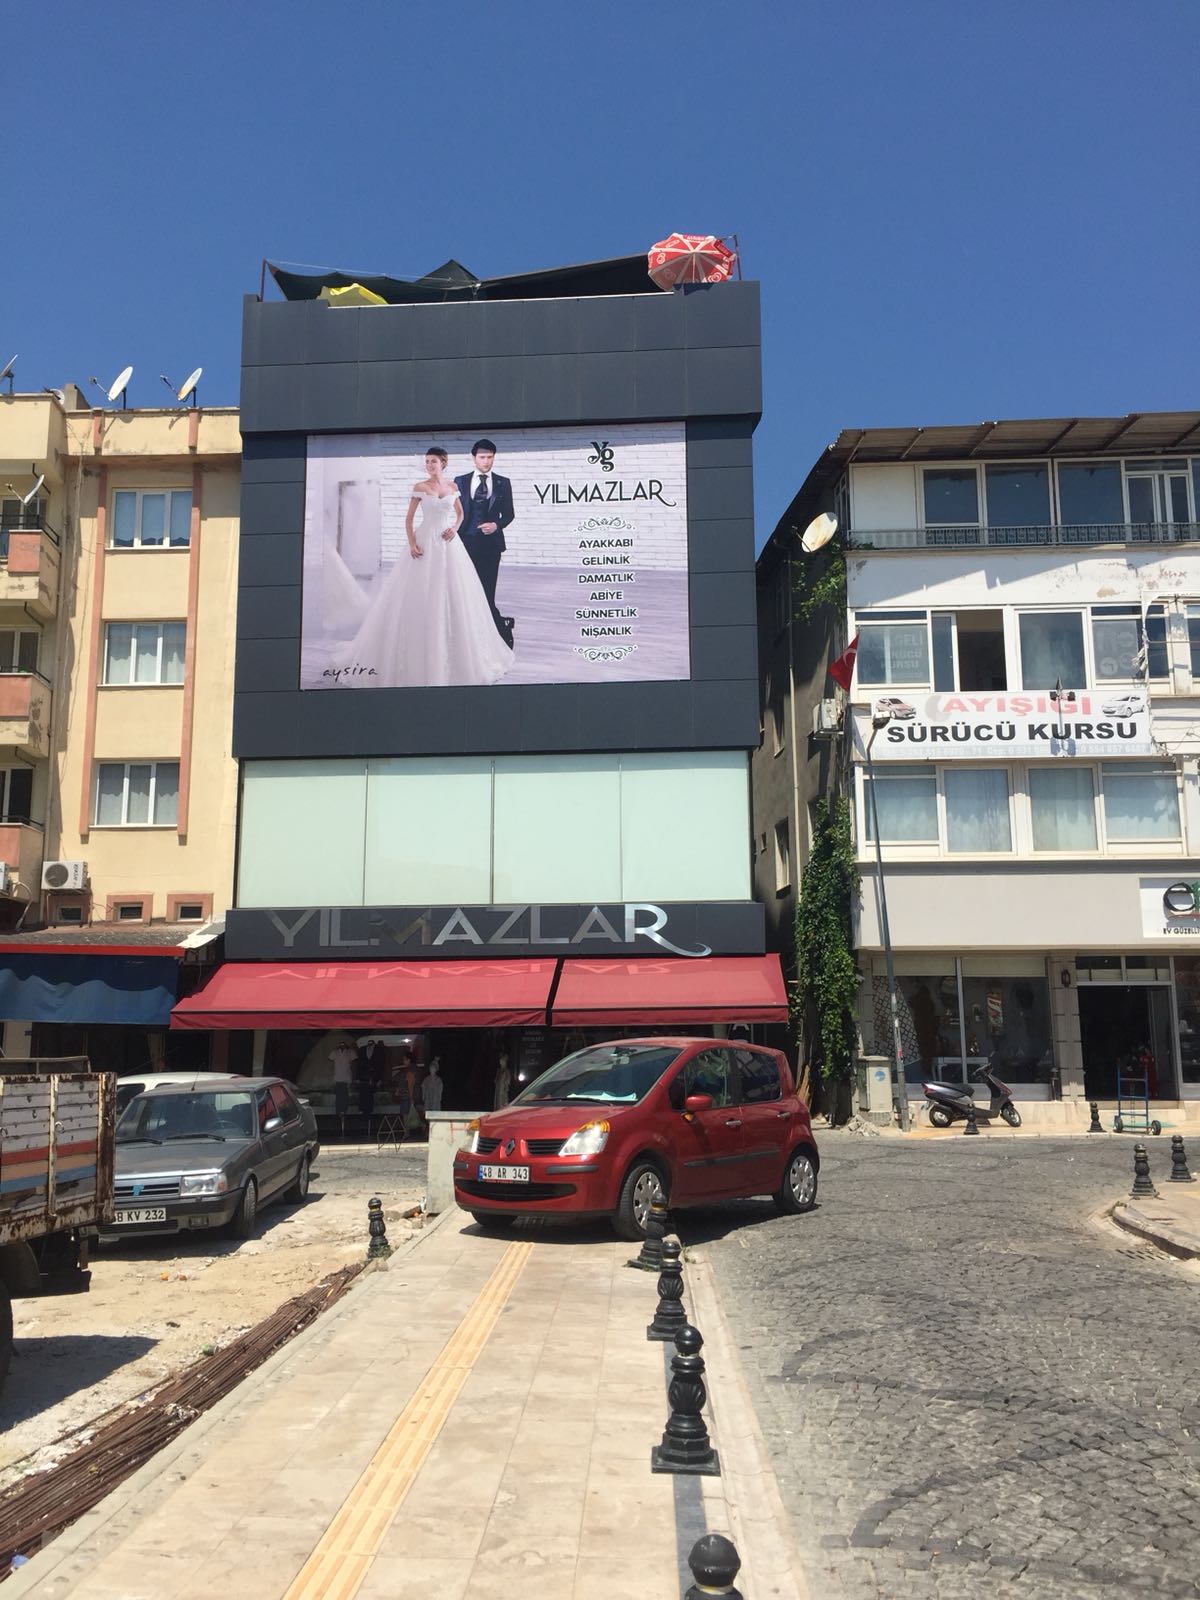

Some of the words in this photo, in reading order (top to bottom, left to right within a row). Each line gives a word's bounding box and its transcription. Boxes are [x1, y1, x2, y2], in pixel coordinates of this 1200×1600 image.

[534, 479, 677, 507] YILMAZLAR
[579, 538, 633, 549] AYAKKABI
[582, 554, 631, 566] GELİNLİK
[578, 573, 634, 583] DAMATLIK
[590, 589, 623, 601] ABİYE
[575, 606, 637, 619] SÜNNETLİK
[581, 626, 632, 638] NİŞANLIK
[323, 663, 378, 683] aysira
[887, 721, 1016, 743] SÜRÜCÜ
[1028, 722, 1138, 740] KURSU
[264, 903, 712, 957] YILMAZLAR
[483, 1167, 492, 1178] 48
[498, 1167, 506, 1179] AR
[512, 1168, 528, 1180] 343
[127, 1211, 140, 1222] KV
[145, 1210, 165, 1221] 232
